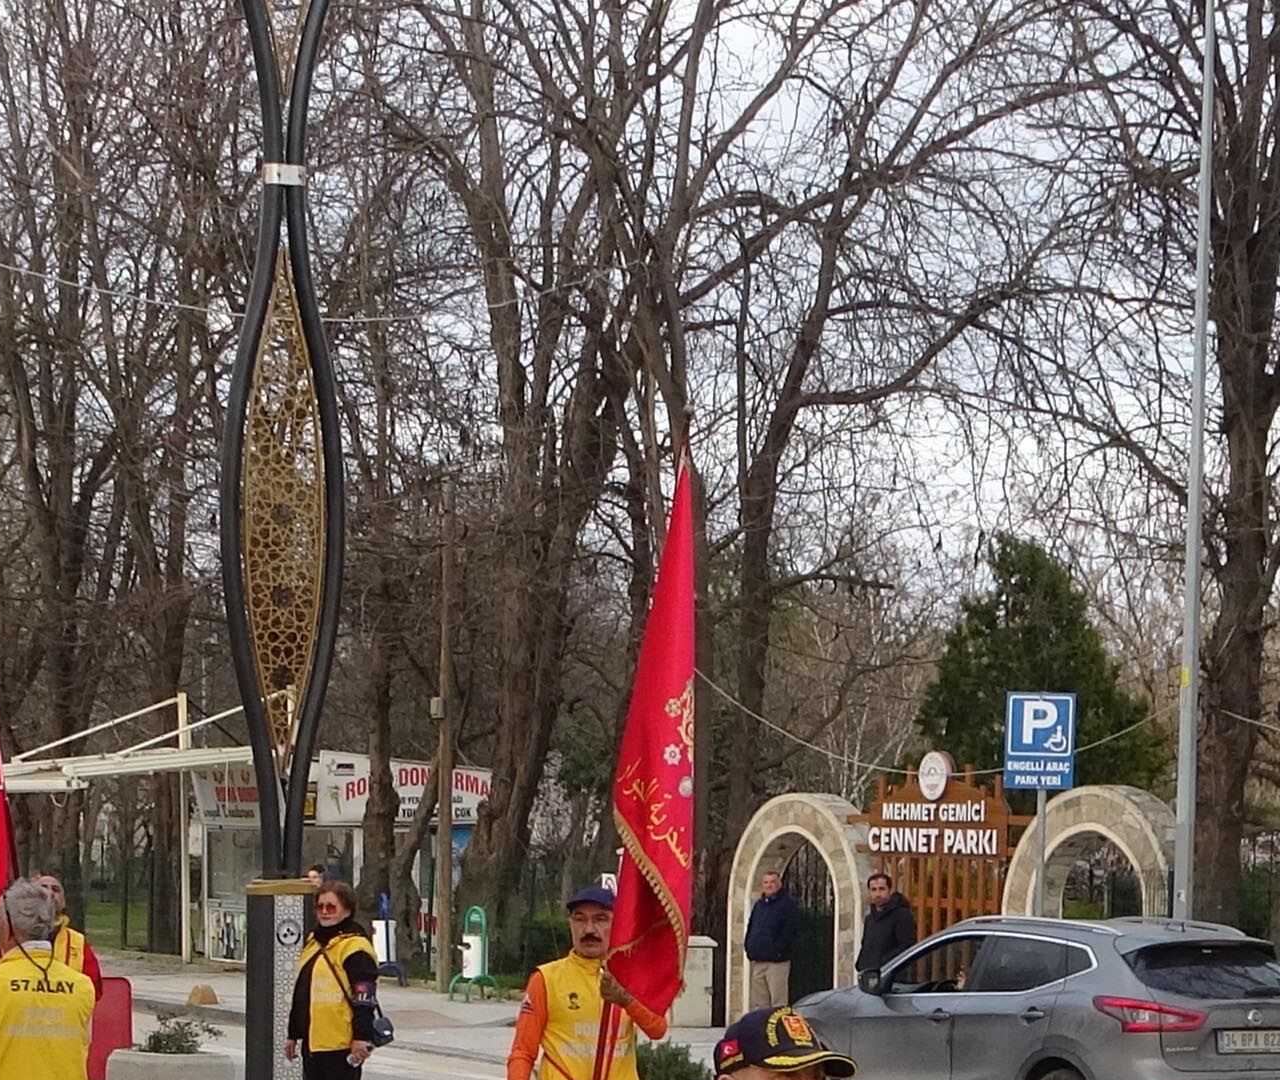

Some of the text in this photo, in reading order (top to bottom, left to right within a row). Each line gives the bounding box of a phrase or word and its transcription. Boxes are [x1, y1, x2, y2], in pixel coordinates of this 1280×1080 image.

[1022, 700, 1058, 745] P
[1006, 759, 1070, 773] ENGELLİ ARAÇ
[1014, 774, 1061, 786] PARK YERİ
[882, 799, 985, 822] MEHMET GEMİCİ
[868, 827, 997, 855] CENNET PARKI
